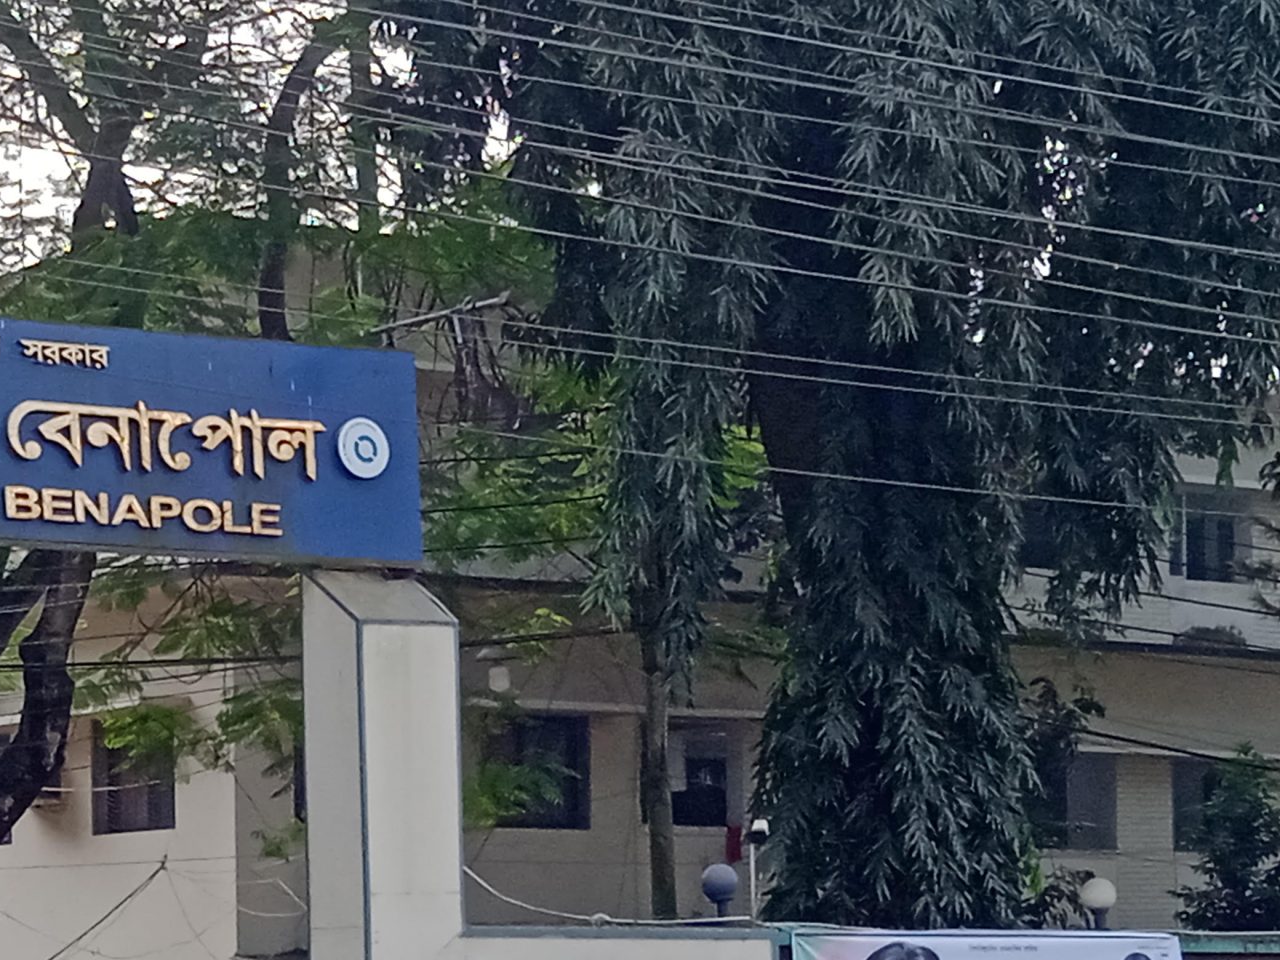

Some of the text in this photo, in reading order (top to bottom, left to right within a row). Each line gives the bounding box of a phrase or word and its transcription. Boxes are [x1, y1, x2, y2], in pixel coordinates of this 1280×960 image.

[20, 337, 111, 370] সরকার
[7, 400, 327, 482] বেনাপোল
[4, 484, 284, 537] BENAPOLE
